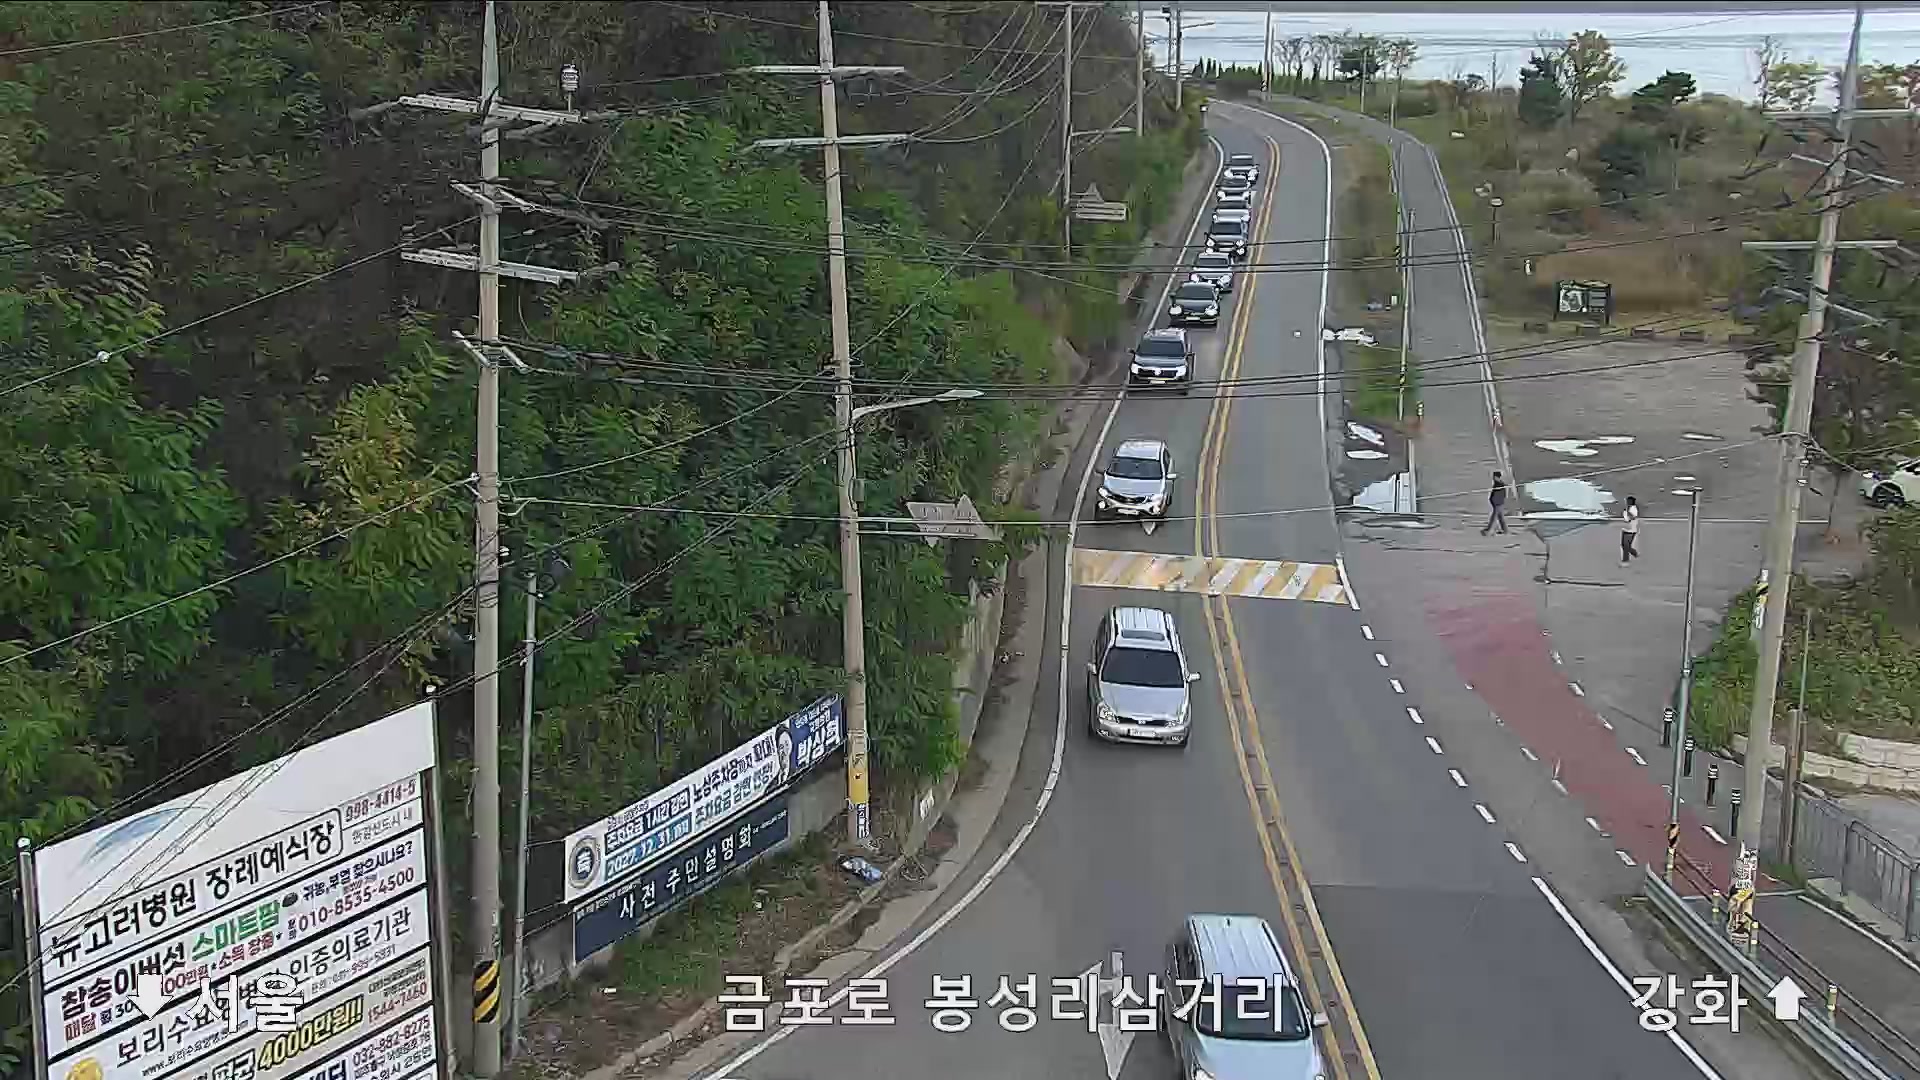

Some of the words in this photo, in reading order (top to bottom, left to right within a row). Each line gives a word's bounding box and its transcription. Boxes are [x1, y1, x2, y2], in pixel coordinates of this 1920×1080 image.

[50, 878, 197, 968] 뉴고려병원
[205, 819, 335, 899] 장례예식장
[299, 867, 415, 933] 010-8535-4500
[620, 880, 657, 919] 사전
